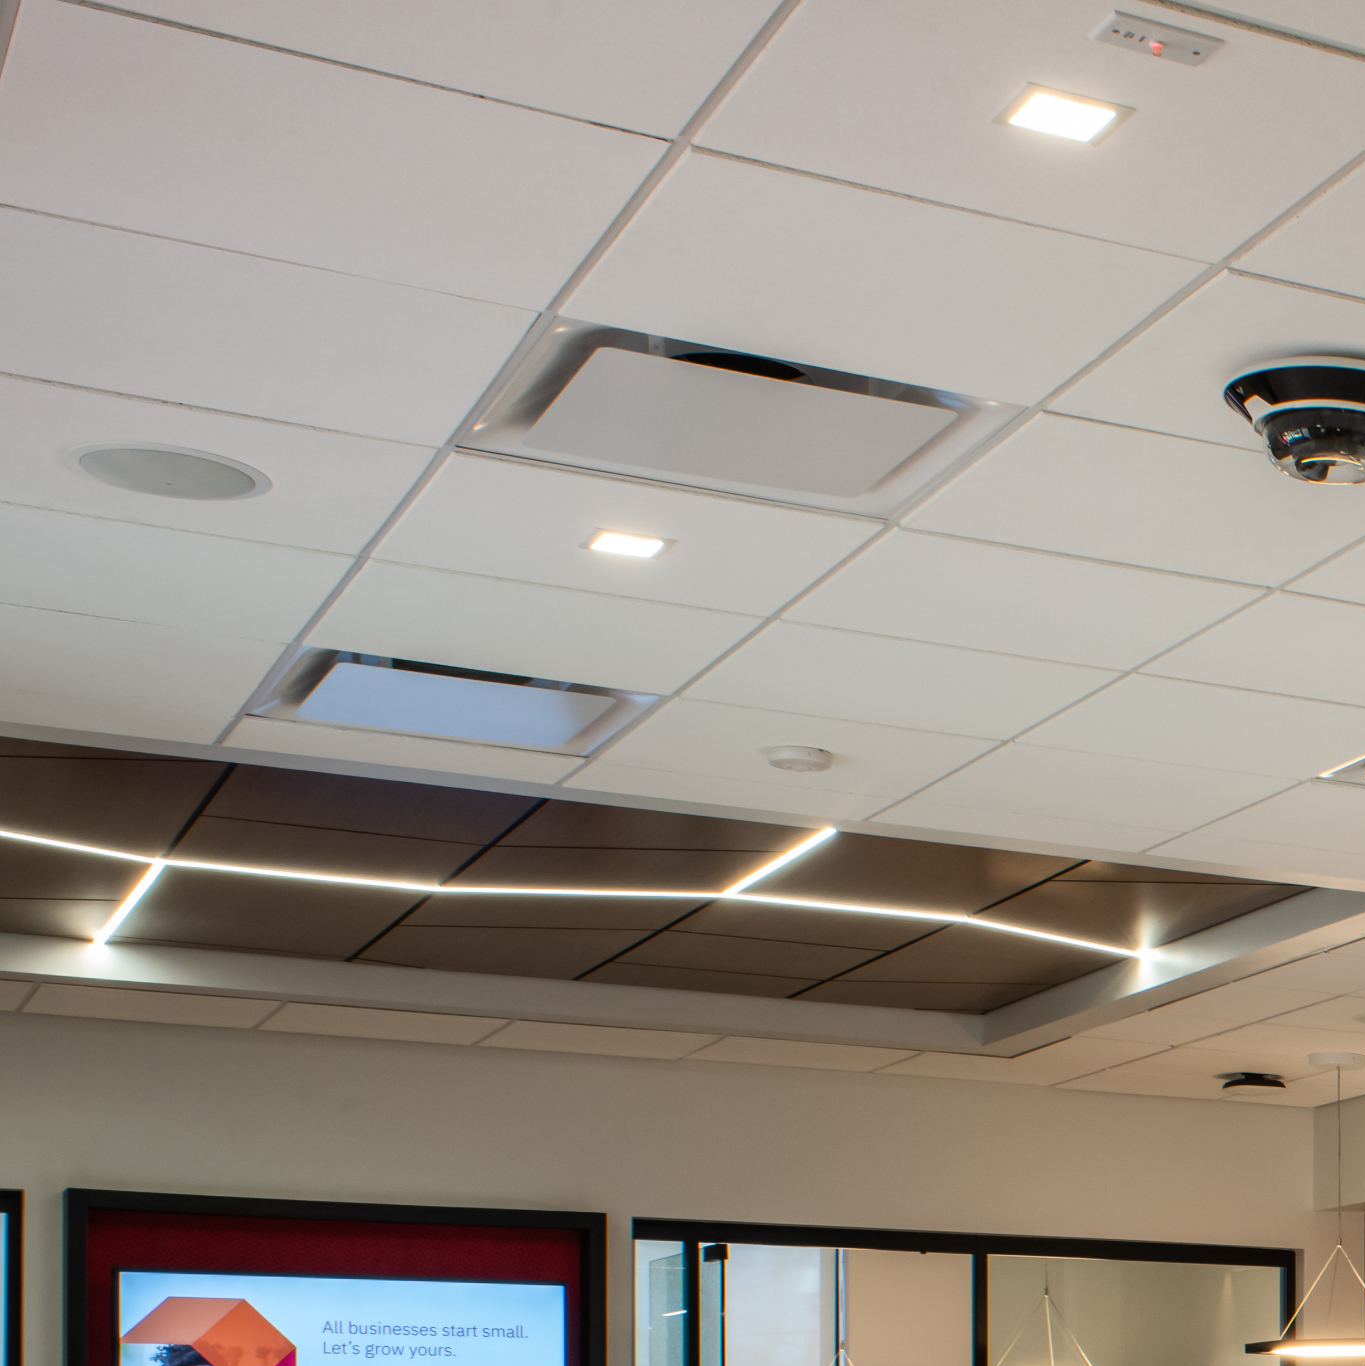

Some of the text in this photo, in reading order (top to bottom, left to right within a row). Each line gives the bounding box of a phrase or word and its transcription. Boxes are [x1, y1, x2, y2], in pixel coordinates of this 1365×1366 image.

[323, 1321, 529, 1339] All businesses start small.
[323, 1341, 457, 1360] Let’s grow yours.
